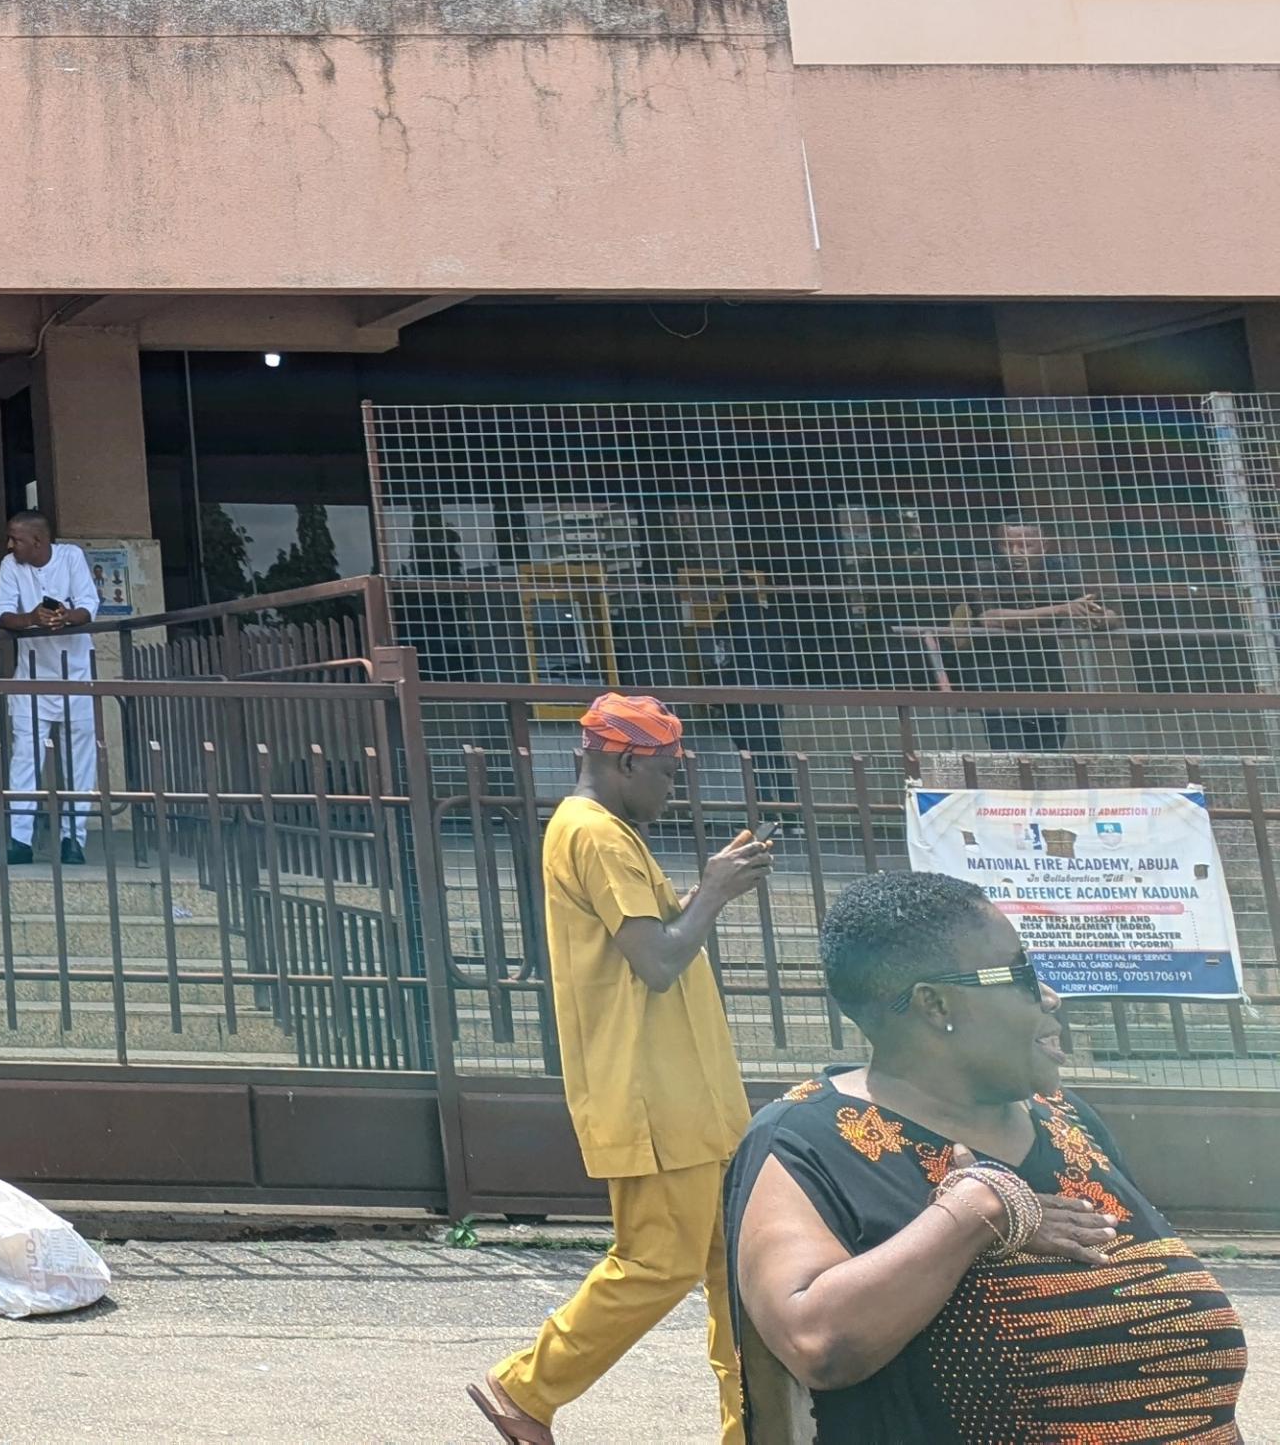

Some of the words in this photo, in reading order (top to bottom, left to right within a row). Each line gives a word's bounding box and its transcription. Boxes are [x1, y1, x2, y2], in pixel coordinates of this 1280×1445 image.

[976, 808, 1026, 816] ADMISSION
[1036, 808, 1086, 816] ADMISSION
[1098, 808, 1148, 816] ADMISSION
[967, 858, 1030, 870] NATIONAL
[1034, 858, 1062, 870] FIRE
[1067, 858, 1133, 871] ACADEMY,
[1138, 858, 1179, 870] ABUJA
[1043, 873, 1100, 882] Collaboration
[1016, 887, 1072, 899] DEFENCE
[1077, 887, 1137, 899] ACADEMY
[1142, 886, 1199, 899] KADUNA
[1116, 923, 1156, 931] (MDRM)
[1129, 941, 1173, 949] (PGDRM)
[1123, 971, 1192, 981] 07051706191
